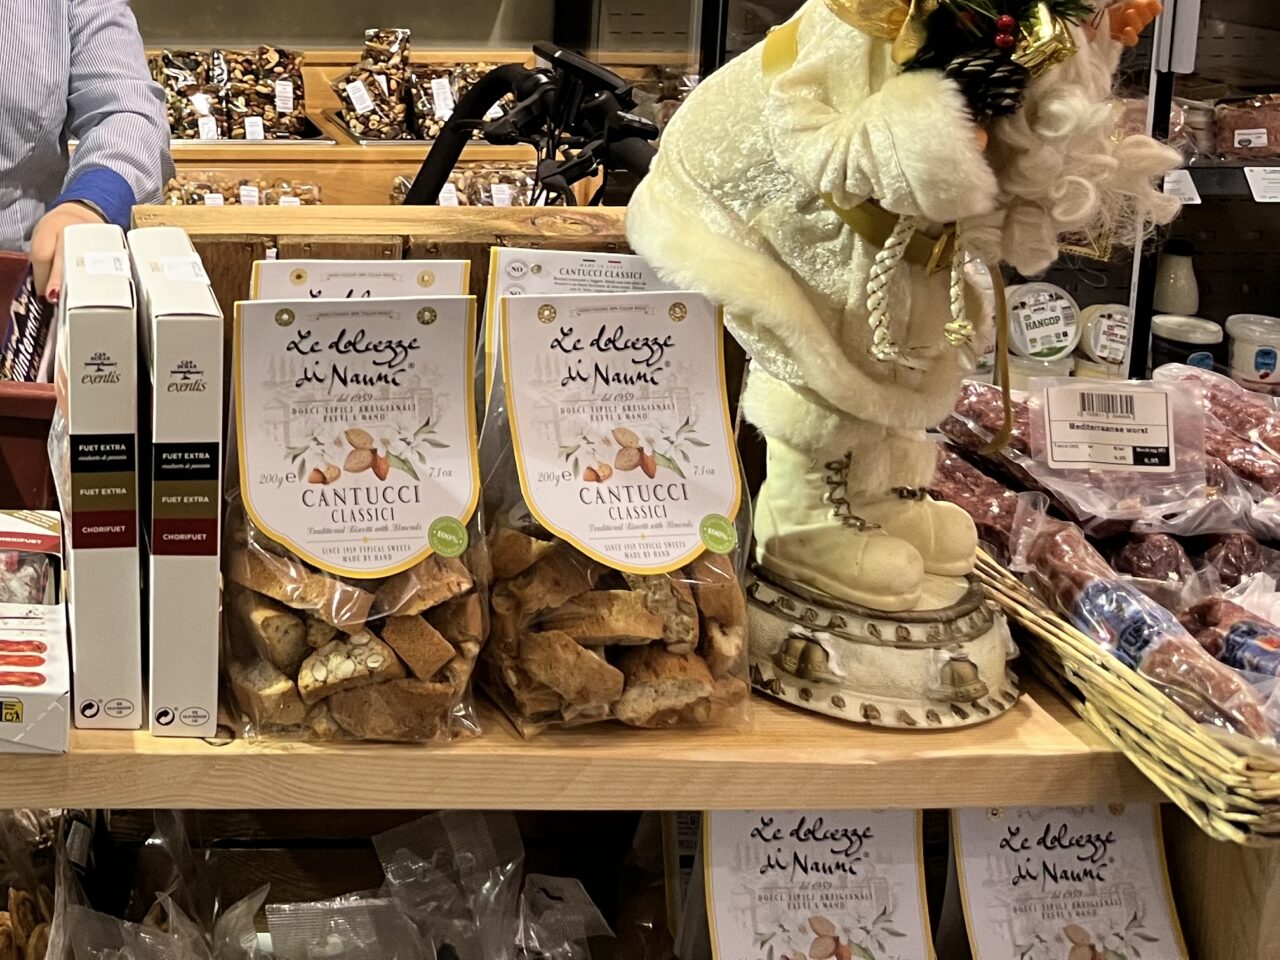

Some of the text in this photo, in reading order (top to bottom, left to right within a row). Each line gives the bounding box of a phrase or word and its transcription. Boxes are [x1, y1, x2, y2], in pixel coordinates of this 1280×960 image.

[511, 265, 523, 273] NO
[559, 267, 642, 280] CANTUCCI CLASSICI
[1025, 315, 1061, 331] HANGOP
[328, 328, 421, 368] dolcezze
[589, 325, 675, 366] dolcezze
[81, 370, 122, 385] exentis
[167, 378, 207, 393] exentis
[259, 472, 283, 487] 200g
[537, 471, 560, 486] 200g
[101, 487, 127, 495] EXTRA
[301, 485, 421, 508] CANTUCCI
[579, 483, 689, 505] CANTUCCI
[331, 507, 395, 523] CLASSICI
[608, 505, 667, 521] CLASSICI
[82, 525, 125, 533] CHORIFUET
[342, 554, 360, 562] MADE
[789, 816, 874, 857] dolcezze
[1037, 823, 1117, 863] dolcezze
